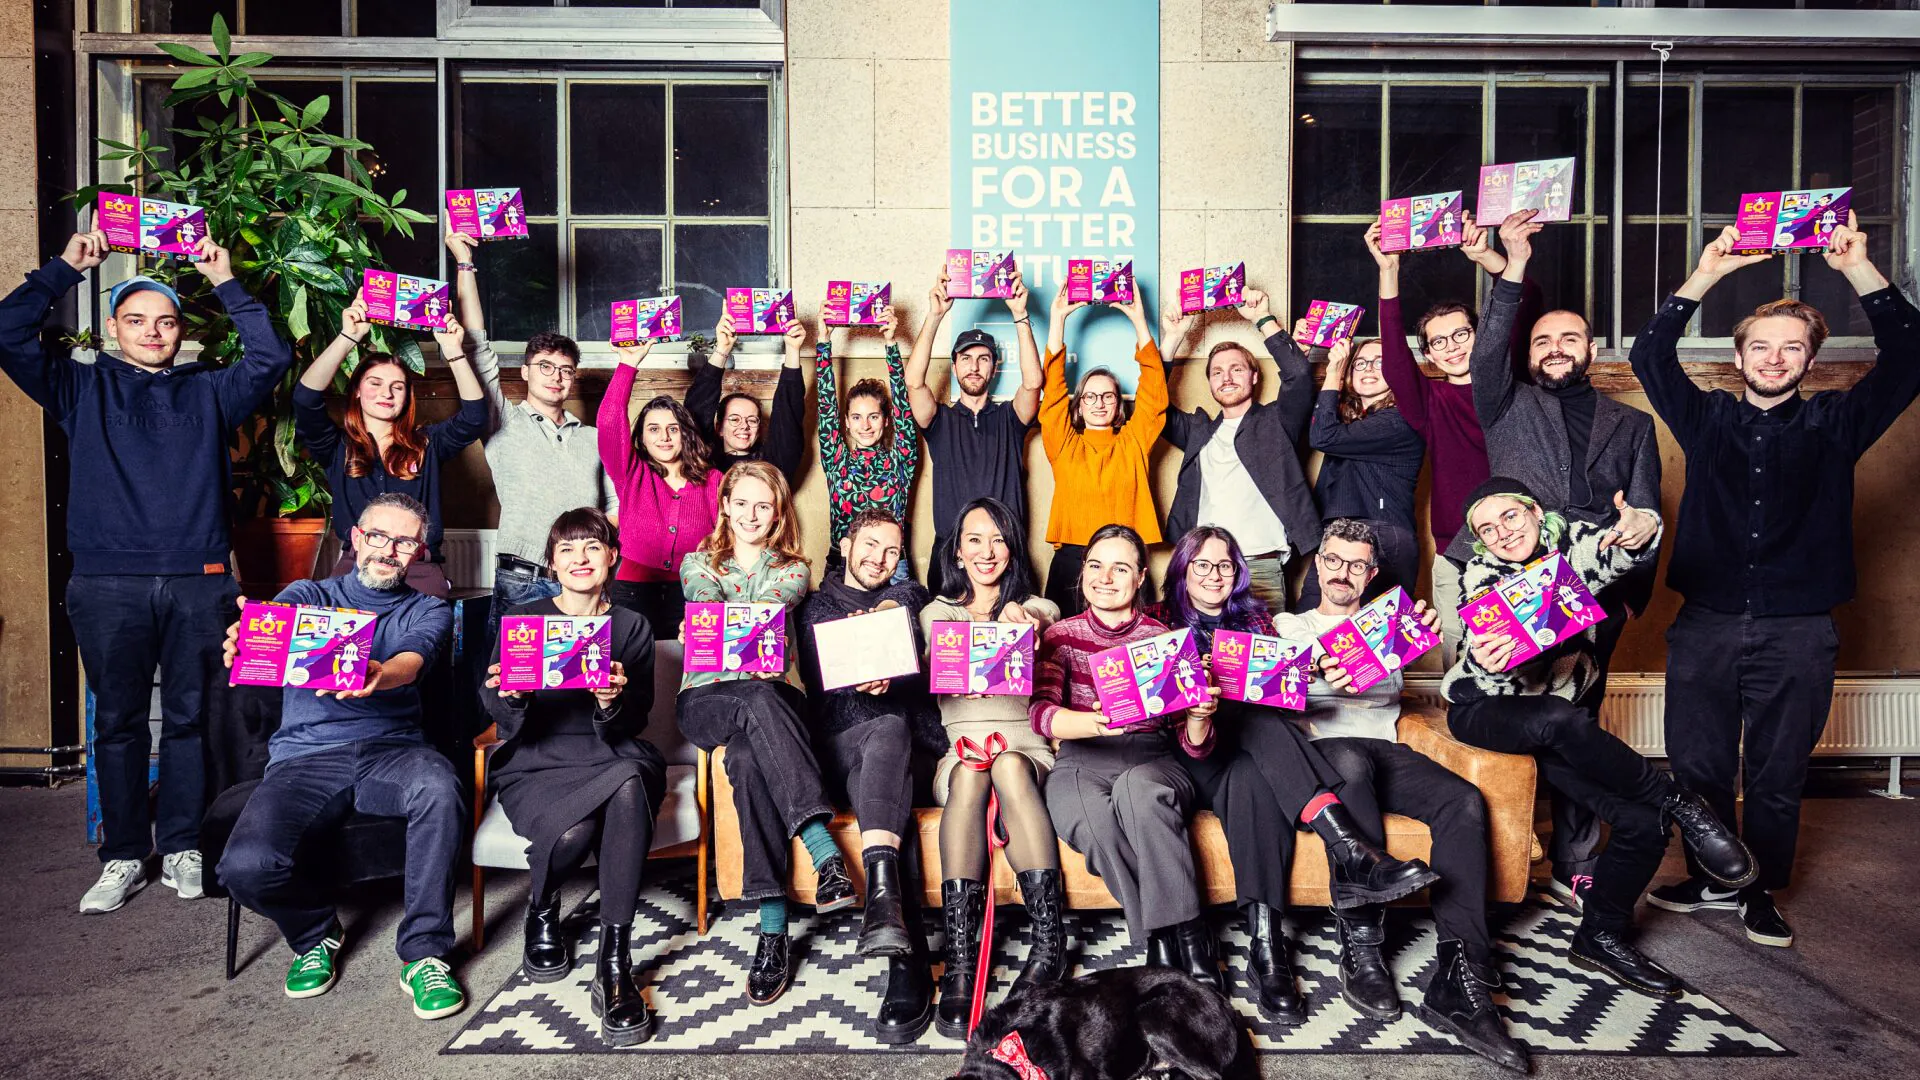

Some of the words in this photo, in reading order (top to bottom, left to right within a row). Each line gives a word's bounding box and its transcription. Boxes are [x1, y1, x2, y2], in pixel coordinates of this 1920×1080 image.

[971, 91, 1136, 126] BETTER
[971, 132, 1137, 160] BUSINESS
[971, 165, 1083, 208] FOR
[1100, 166, 1136, 207] A
[1485, 175, 1509, 186] EQT
[105, 201, 134, 213] EQT
[451, 198, 472, 207] EQT
[1745, 201, 1775, 214] EQT
[1385, 207, 1406, 217] EQT
[971, 213, 1136, 247] BETTER
[950, 257, 968, 267] EQT
[1071, 265, 1089, 274] EQT
[369, 278, 393, 290] EQT
[1183, 275, 1200, 285] EQT
[831, 287, 848, 296] EQT
[730, 295, 749, 305] EQT
[615, 306, 633, 316] EQT
[691, 614, 719, 628] EQT
[1471, 604, 1503, 628] EQT
[249, 617, 287, 636] EQT
[507, 629, 538, 643] EQT
[936, 633, 964, 648] EQT
[1330, 631, 1356, 654] EQT
[1218, 641, 1246, 657] EQT
[1096, 659, 1125, 679] EQT
